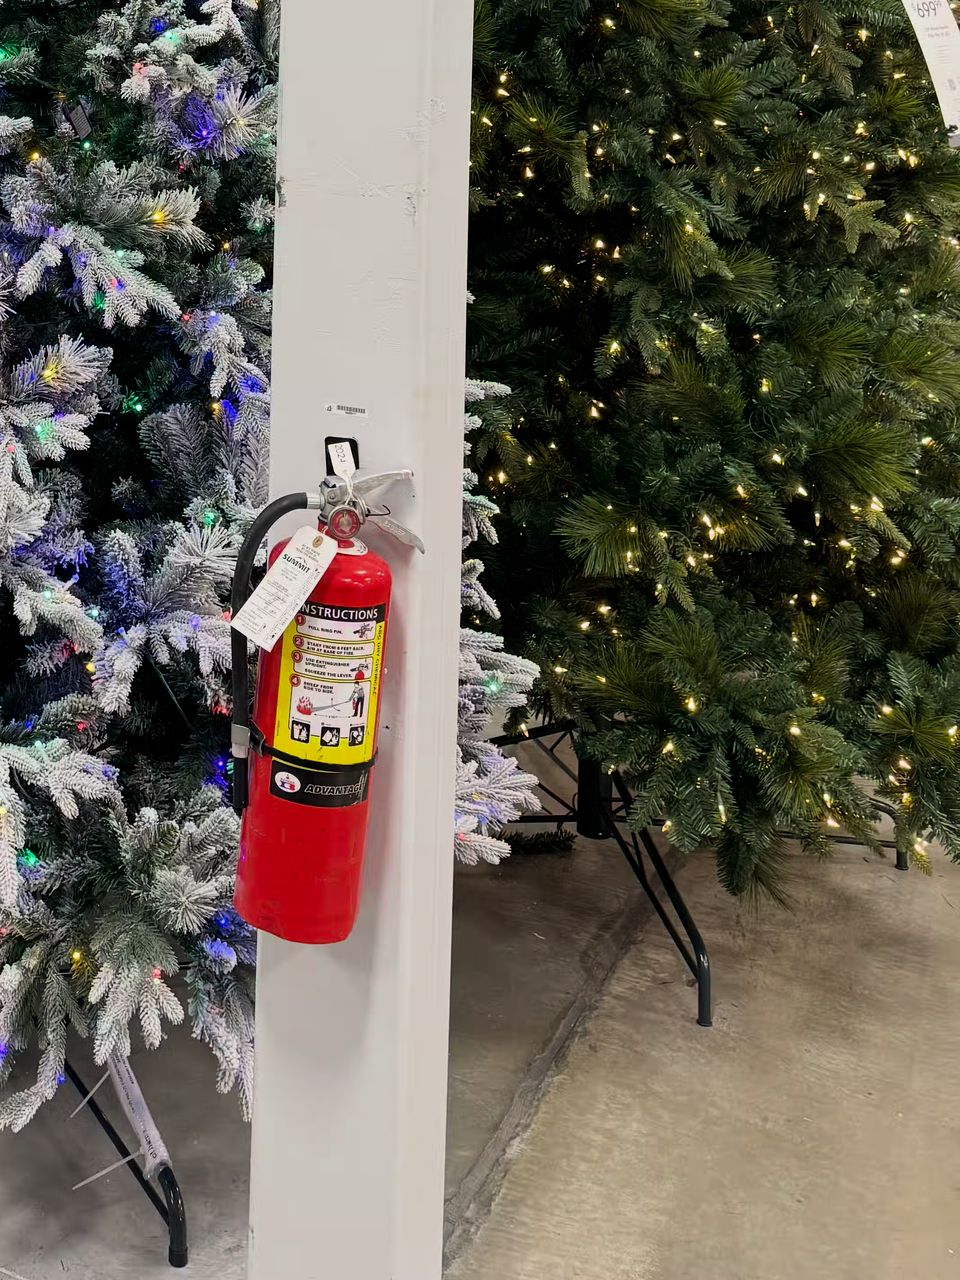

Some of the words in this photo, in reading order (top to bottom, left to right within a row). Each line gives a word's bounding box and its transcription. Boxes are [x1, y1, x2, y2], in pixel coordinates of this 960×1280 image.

[282, 553, 311, 574] SUMMIT
[302, 603, 378, 620] NSTRUCTIONS
[304, 783, 363, 796] ADVANTAG
